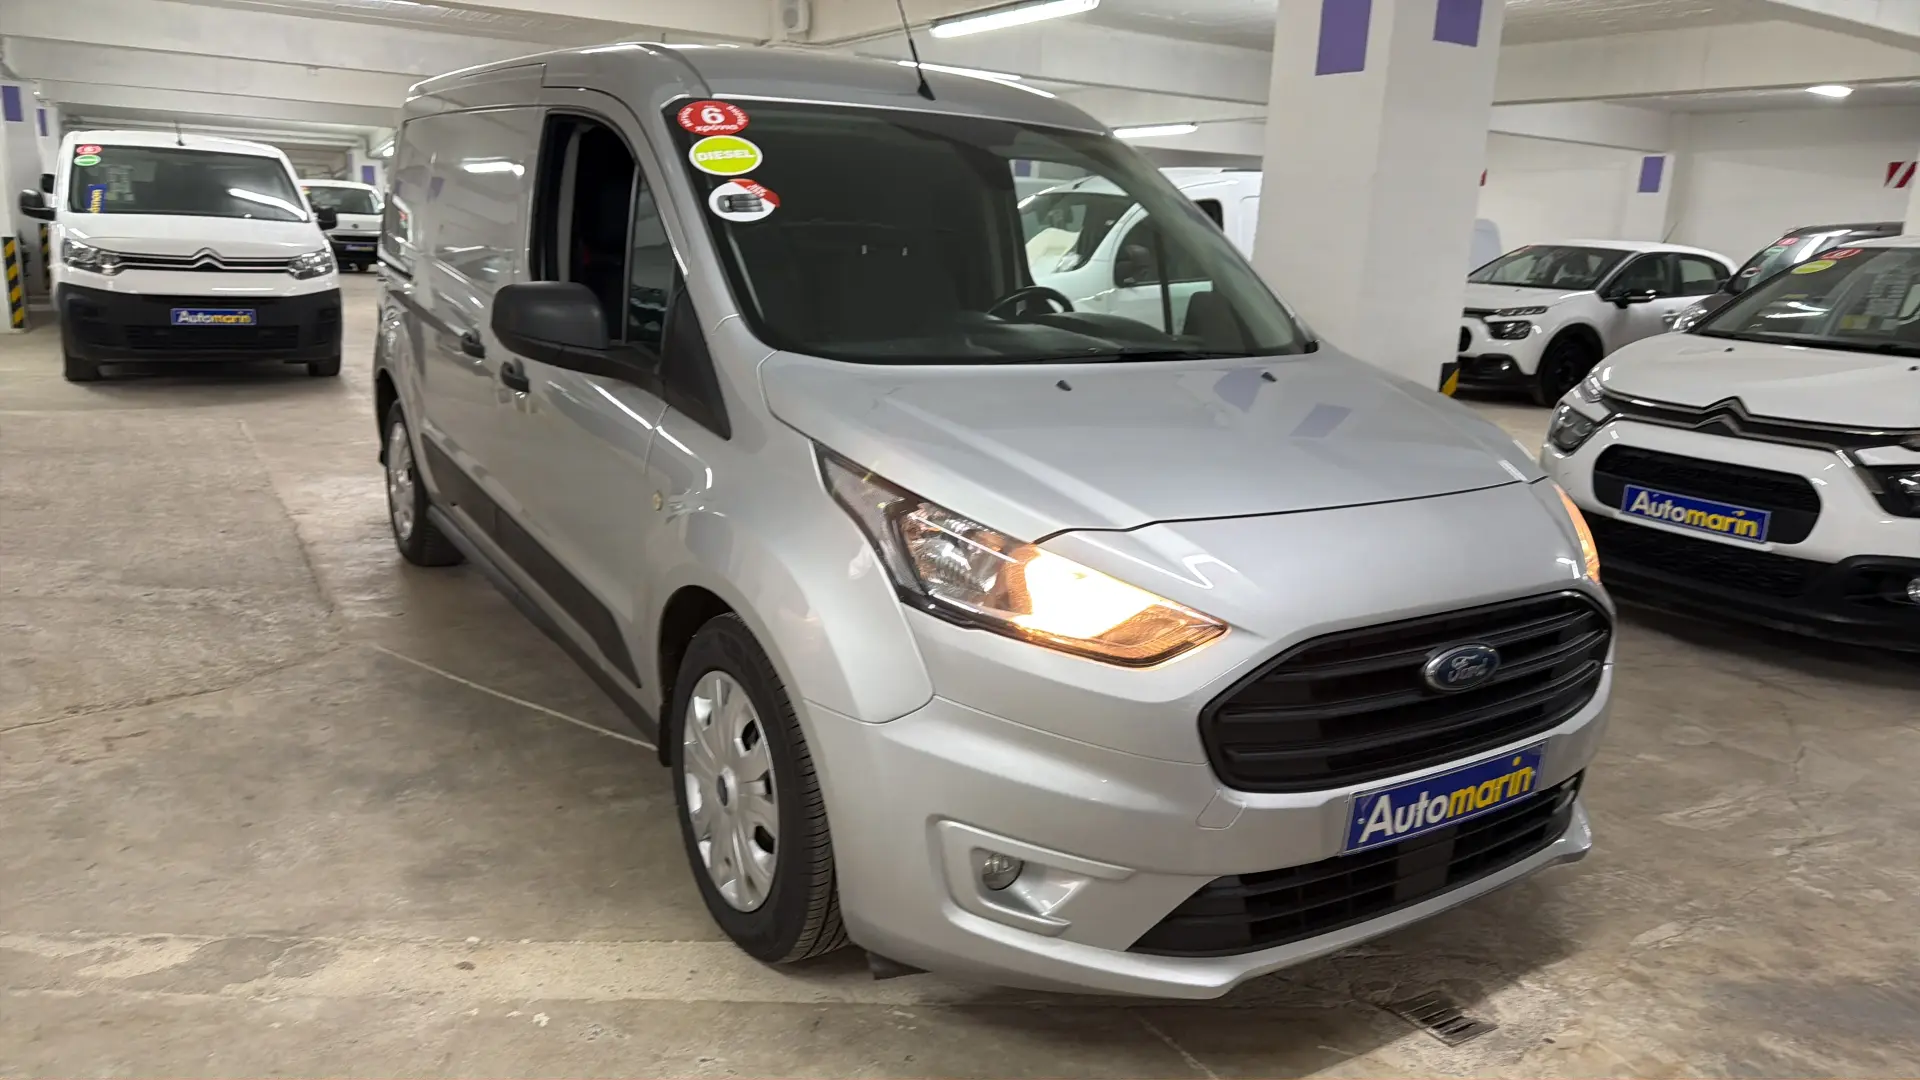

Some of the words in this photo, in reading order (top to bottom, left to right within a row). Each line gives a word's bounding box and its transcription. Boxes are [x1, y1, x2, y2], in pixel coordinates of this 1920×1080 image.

[701, 107, 725, 124] 6
[696, 149, 757, 161] DIESEL
[1629, 490, 1758, 537] Automarin
[1447, 654, 1489, 682] Ford
[1357, 756, 1534, 843] Automarin
